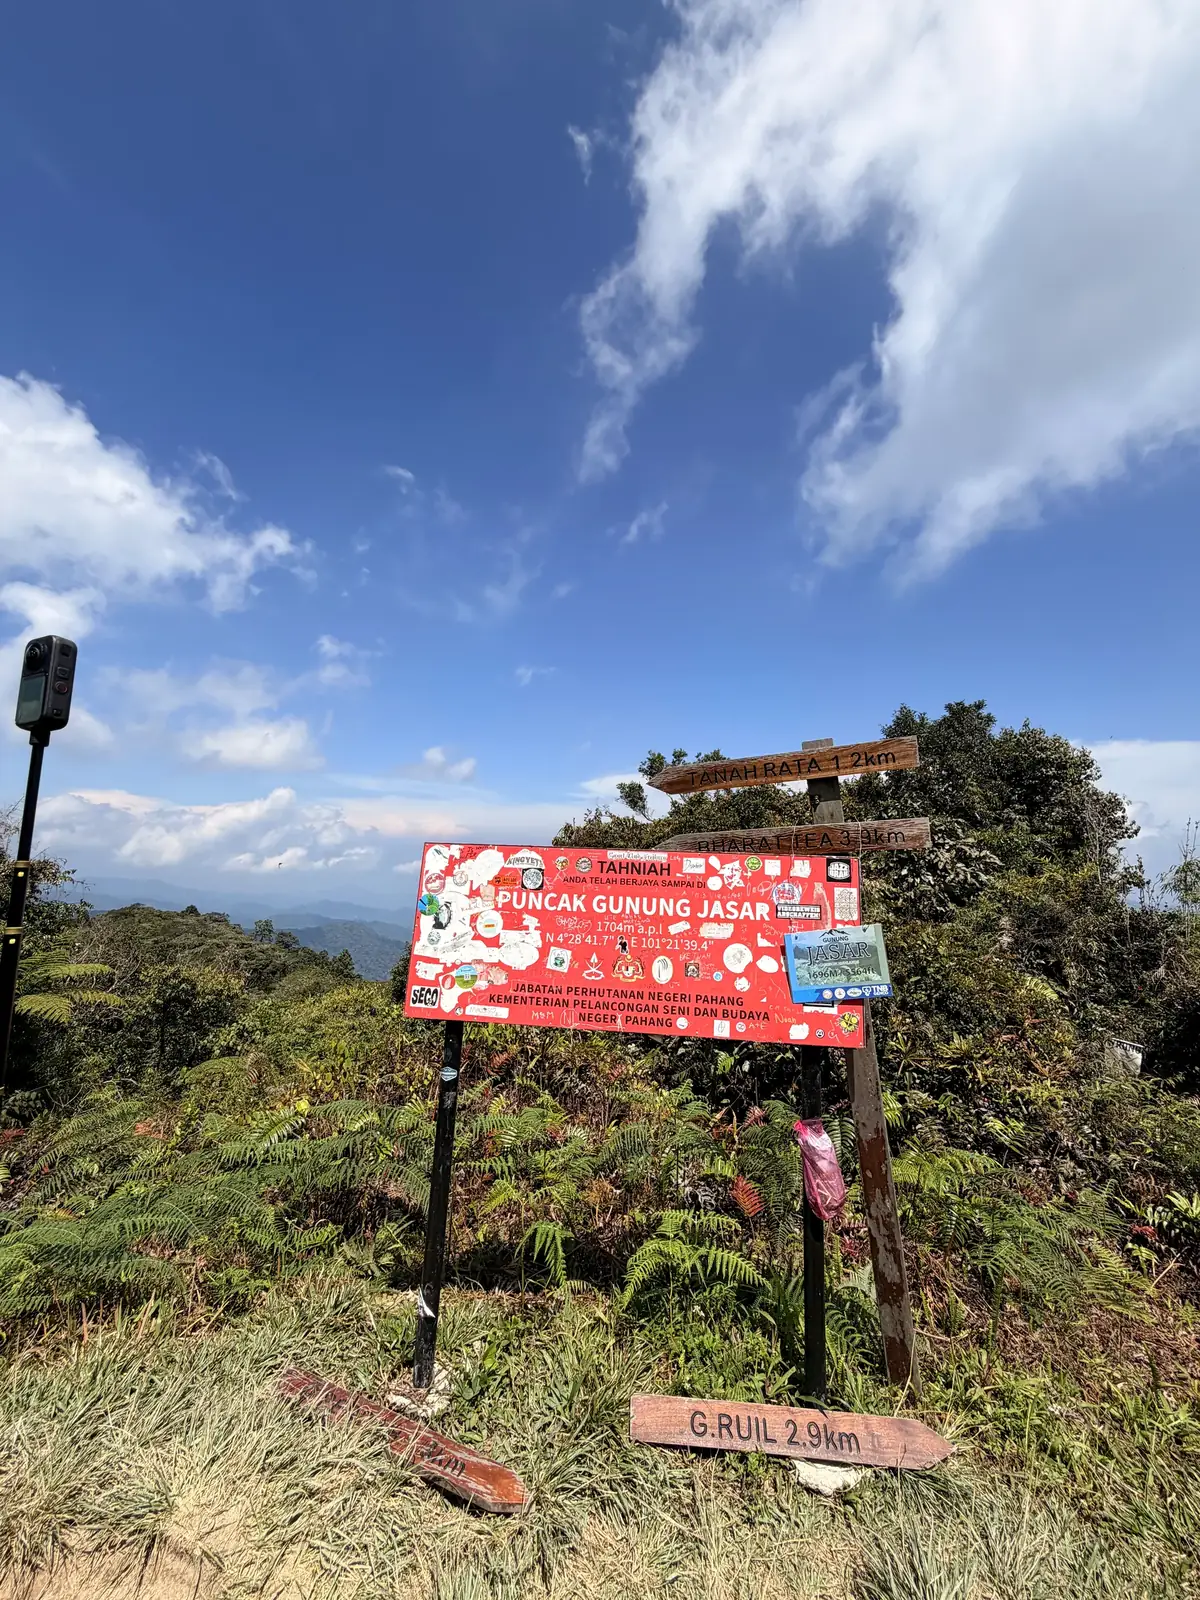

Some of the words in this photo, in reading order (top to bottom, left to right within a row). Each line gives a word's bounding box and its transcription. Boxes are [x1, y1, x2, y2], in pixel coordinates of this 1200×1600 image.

[687, 764, 757, 786] TANAH
[764, 757, 822, 777] RATA
[697, 834, 787, 853] BHARAT
[795, 830, 834, 848] TEA
[598, 861, 671, 877] TAHNIAH
[562, 876, 587, 884] ANDA
[589, 876, 617, 886] TELAH
[619, 877, 659, 888] BERJAYA
[661, 880, 695, 889] SAMPAI
[696, 881, 706, 889] DI
[498, 890, 587, 912] PUNCAK
[592, 895, 691, 917] GUNUNG
[697, 899, 771, 921] JASAR
[596, 921, 635, 933] 1704m
[545, 933, 554, 943] N
[631, 936, 638, 948] E
[822, 935, 849, 943] GUNUNG
[806, 941, 871, 966] JASAR
[513, 983, 562, 995] JABATAN
[566, 986, 644, 1000] PERHUTANAN
[648, 991, 691, 1003] NEGERI
[695, 994, 744, 1006] PAHANG
[489, 994, 569, 1008] KEMENTERIAN
[573, 999, 659, 1013] PELANCONGAN
[663, 1004, 690, 1016] SENI
[694, 1007, 718, 1018] DAN
[722, 1009, 770, 1021] BUDAYA
[625, 1015, 673, 1028] PAHANG
[690, 1410, 777, 1444] G.RUIL
[786, 1418, 861, 1454] 2.9km
